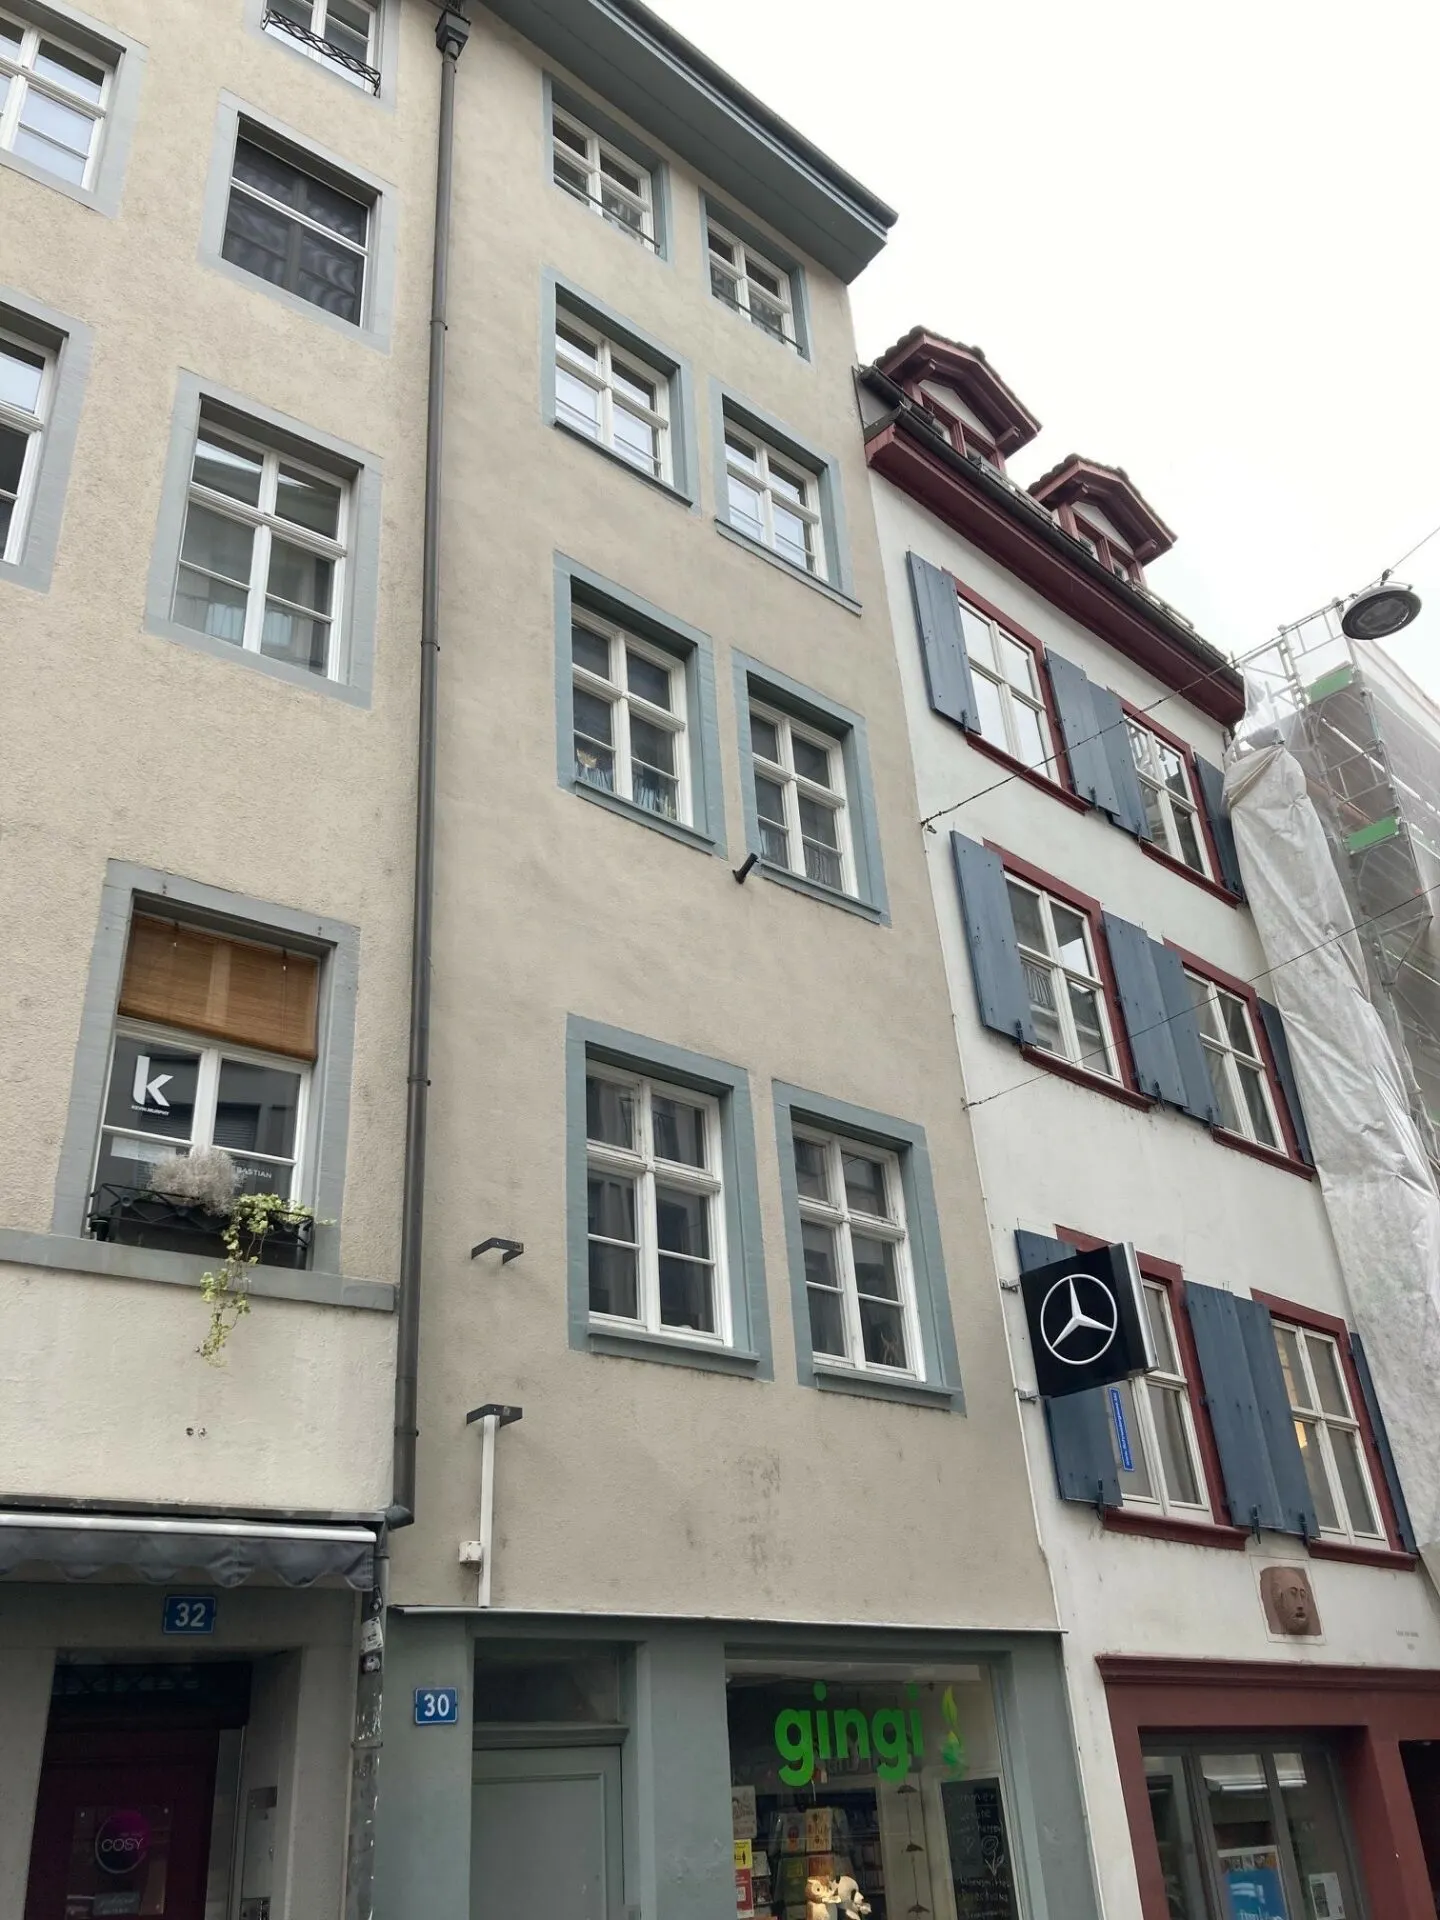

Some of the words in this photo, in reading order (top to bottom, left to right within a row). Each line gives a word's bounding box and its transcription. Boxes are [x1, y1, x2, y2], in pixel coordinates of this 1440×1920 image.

[175, 1603, 206, 1628] 32
[424, 1693, 449, 1717] 30
[774, 1681, 925, 1787] gingi
[101, 1837, 144, 1852] COSY
